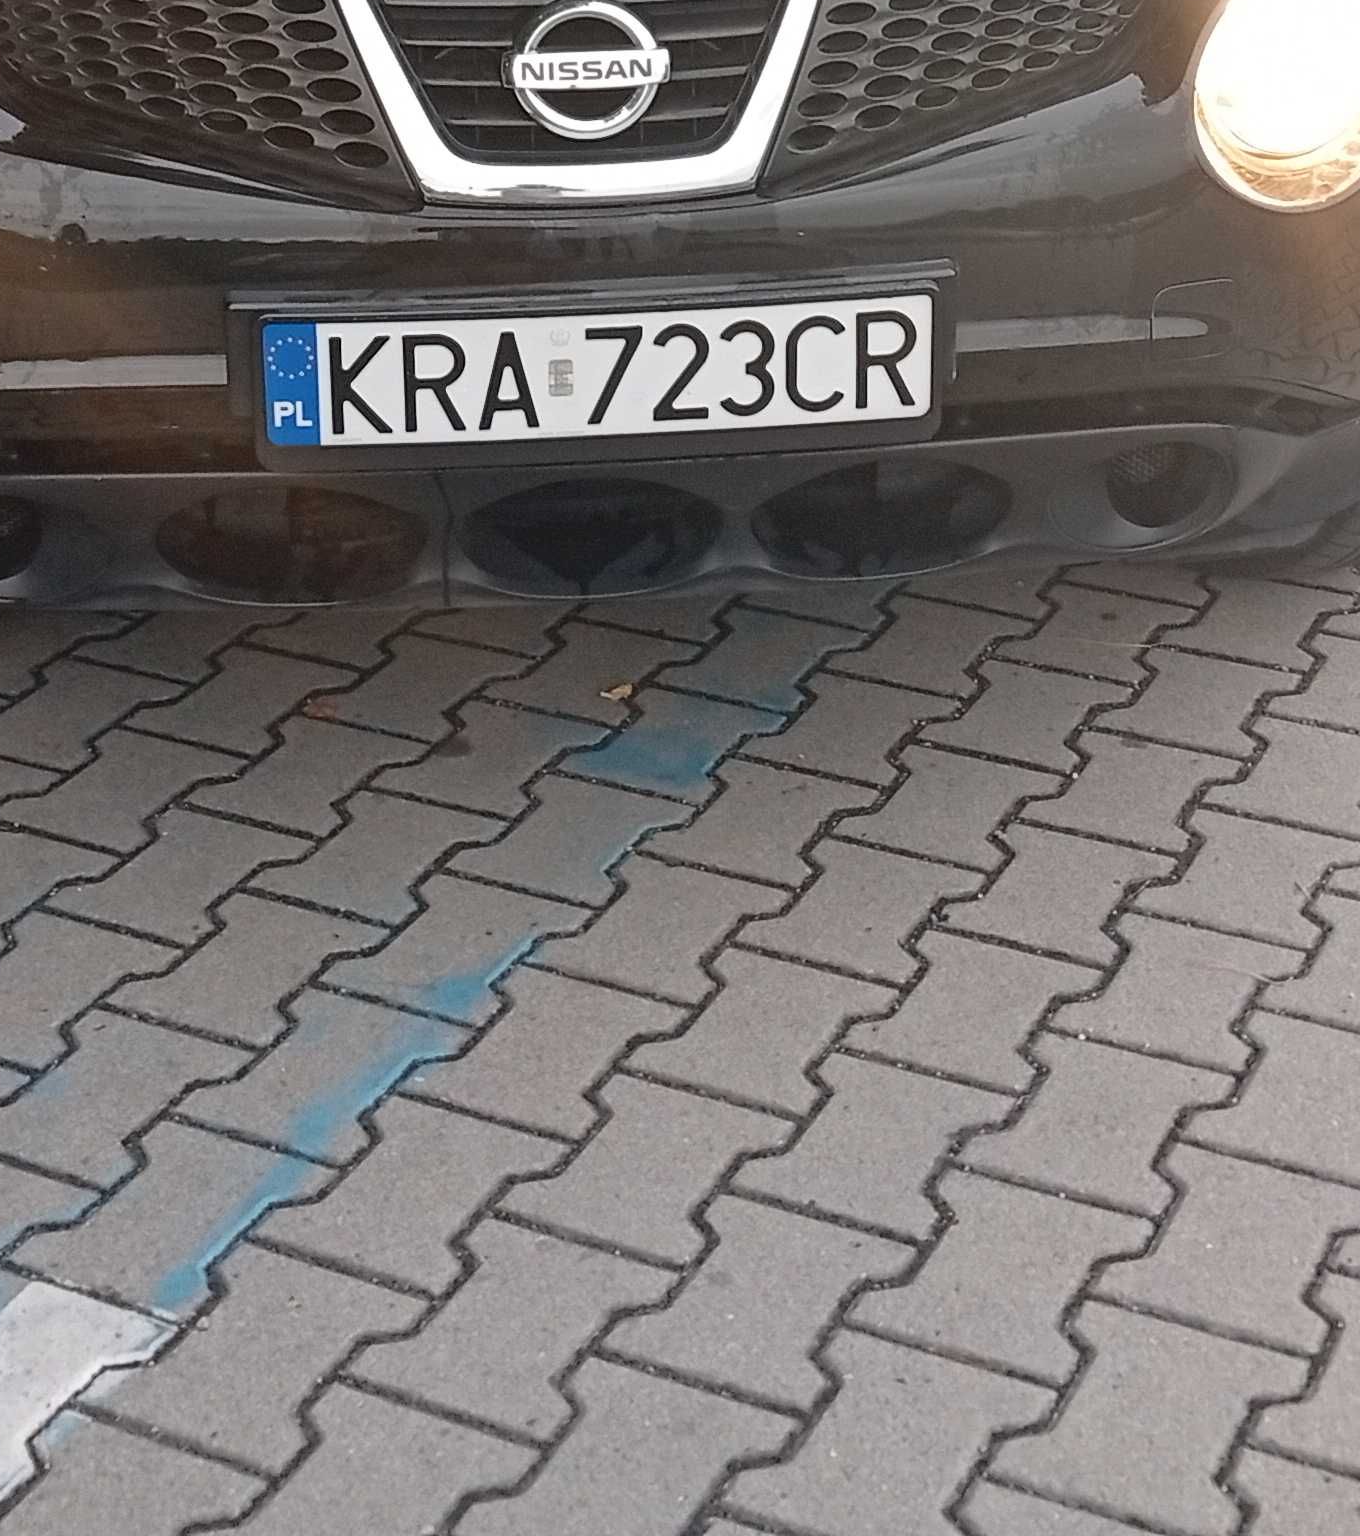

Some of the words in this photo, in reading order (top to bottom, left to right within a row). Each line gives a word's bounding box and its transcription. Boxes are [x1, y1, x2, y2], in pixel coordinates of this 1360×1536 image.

[521, 58, 652, 81] NISSAN
[329, 332, 540, 435] KRA
[585, 311, 917, 425] 723CR
[273, 400, 313, 428] PL
